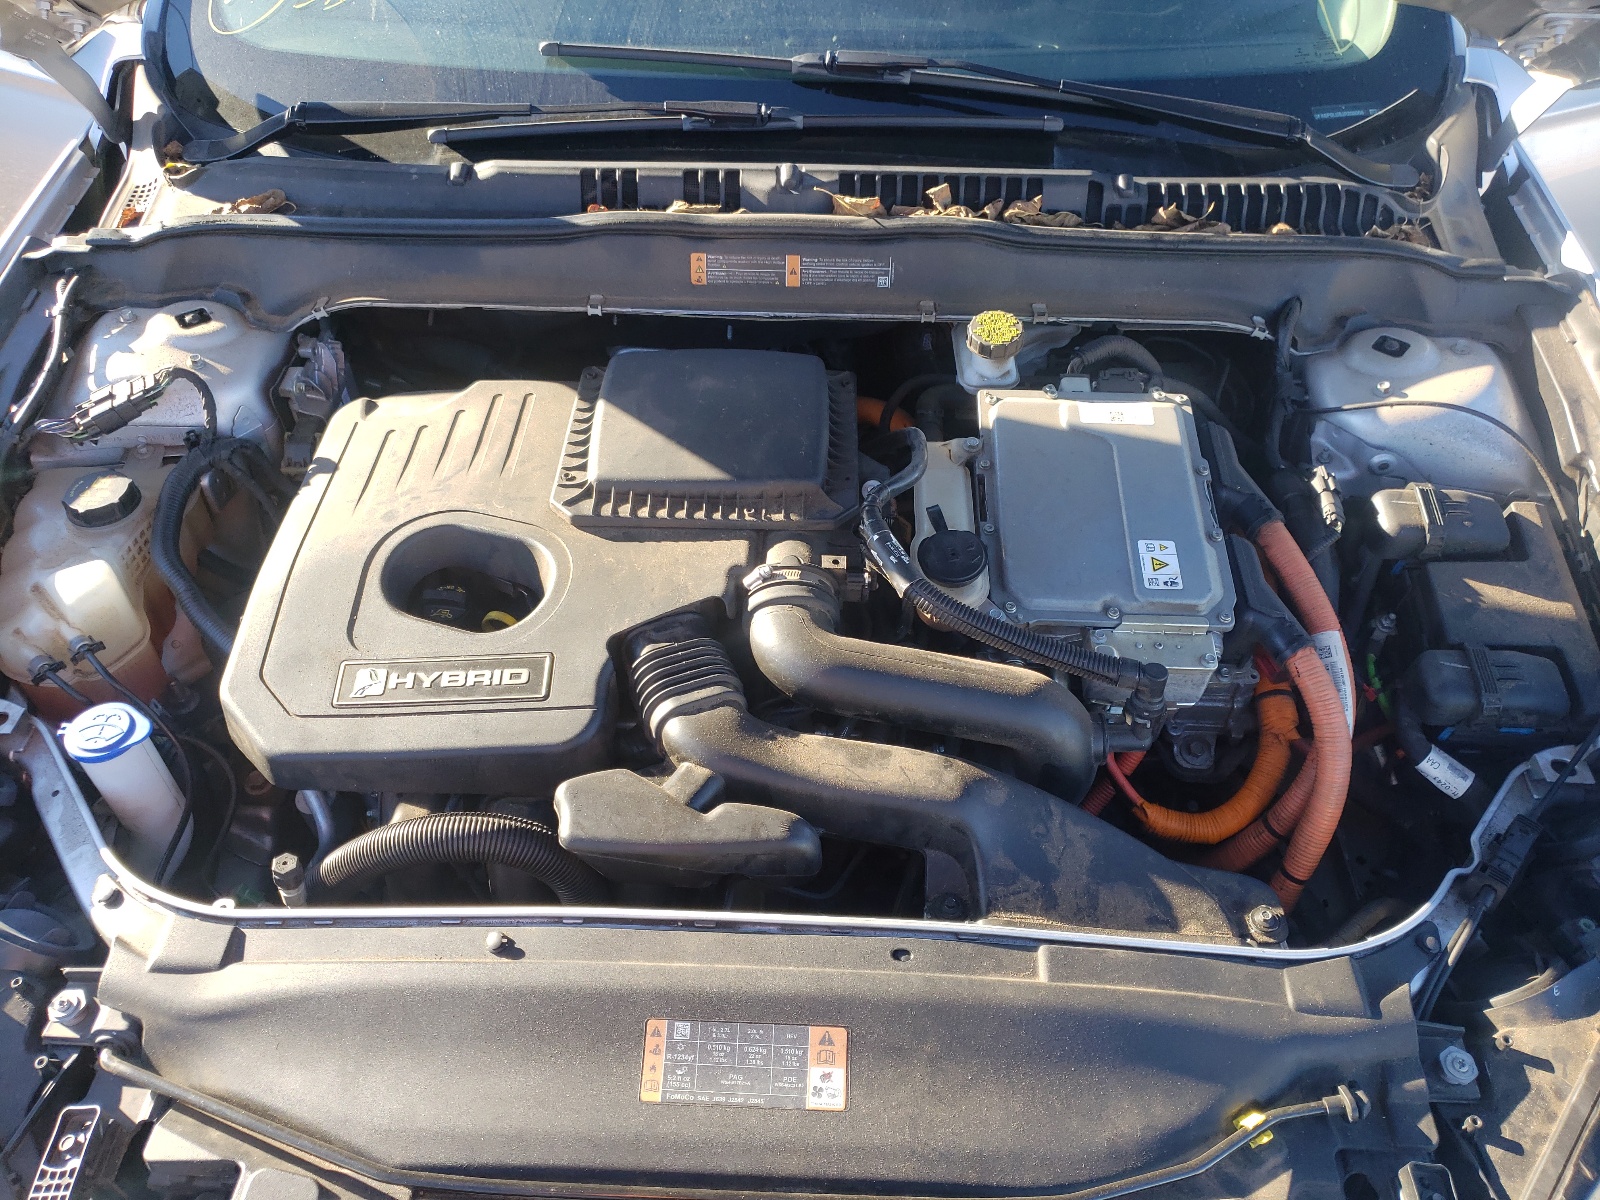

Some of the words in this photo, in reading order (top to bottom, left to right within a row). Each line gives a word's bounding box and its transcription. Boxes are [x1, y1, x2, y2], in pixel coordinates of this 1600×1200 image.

[388, 668, 531, 690] HYBRID
[666, 1053, 695, 1063] R-1234yf
[666, 1092, 694, 1100] FoMoCo
